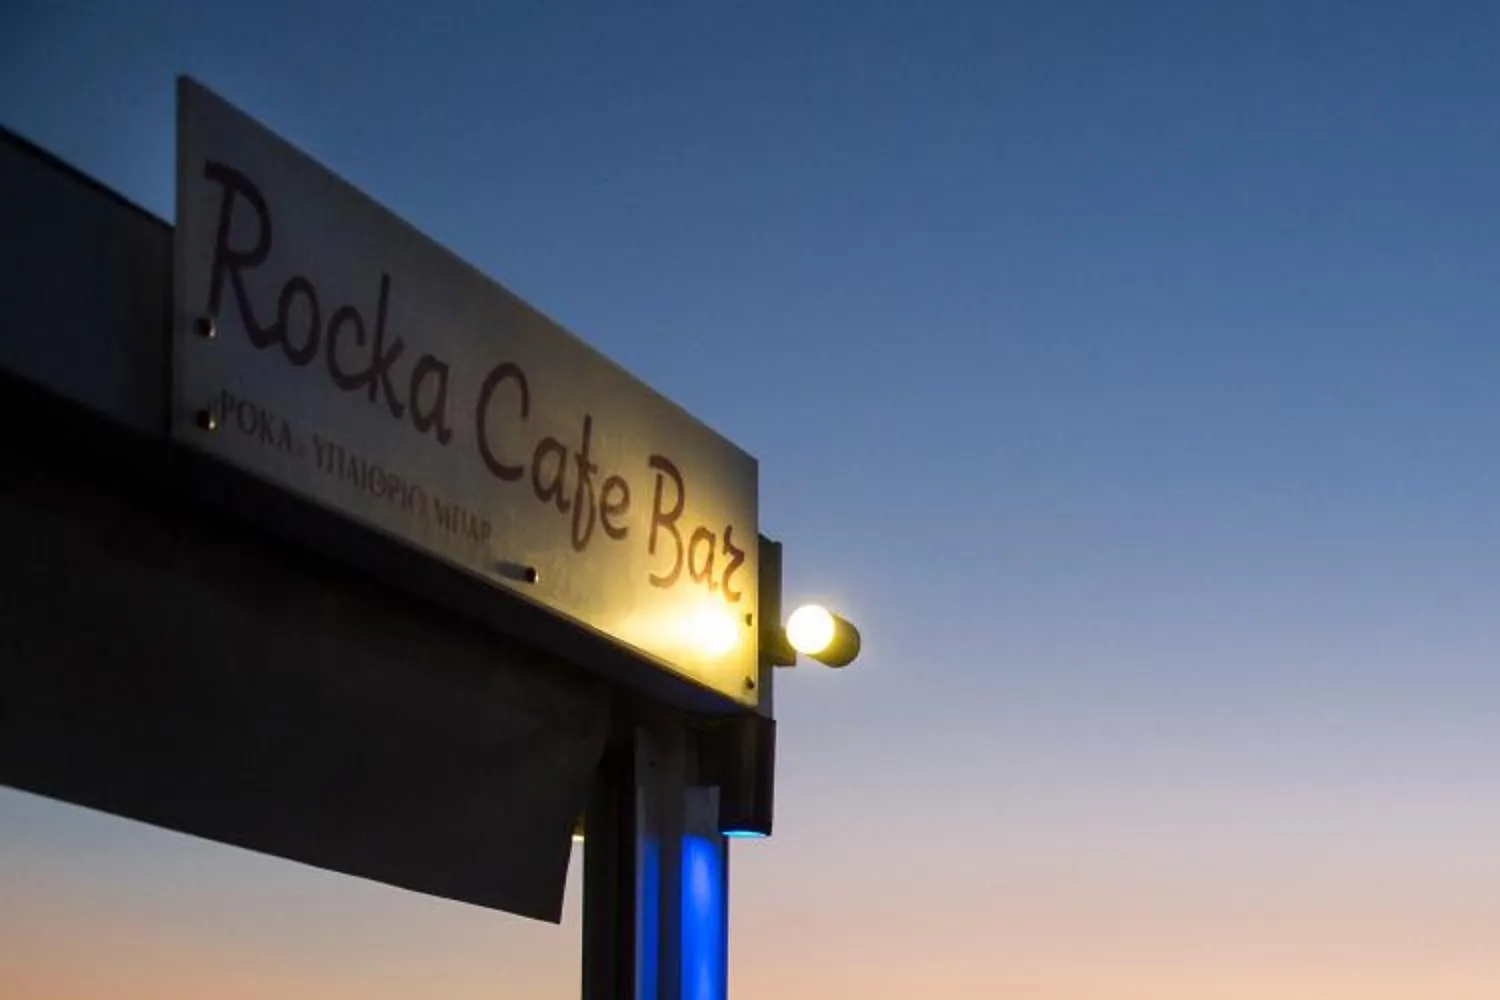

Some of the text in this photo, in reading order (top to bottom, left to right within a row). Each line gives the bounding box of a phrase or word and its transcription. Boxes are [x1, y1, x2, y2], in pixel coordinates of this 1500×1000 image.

[204, 159, 745, 604] Rocka Cafe Bar
